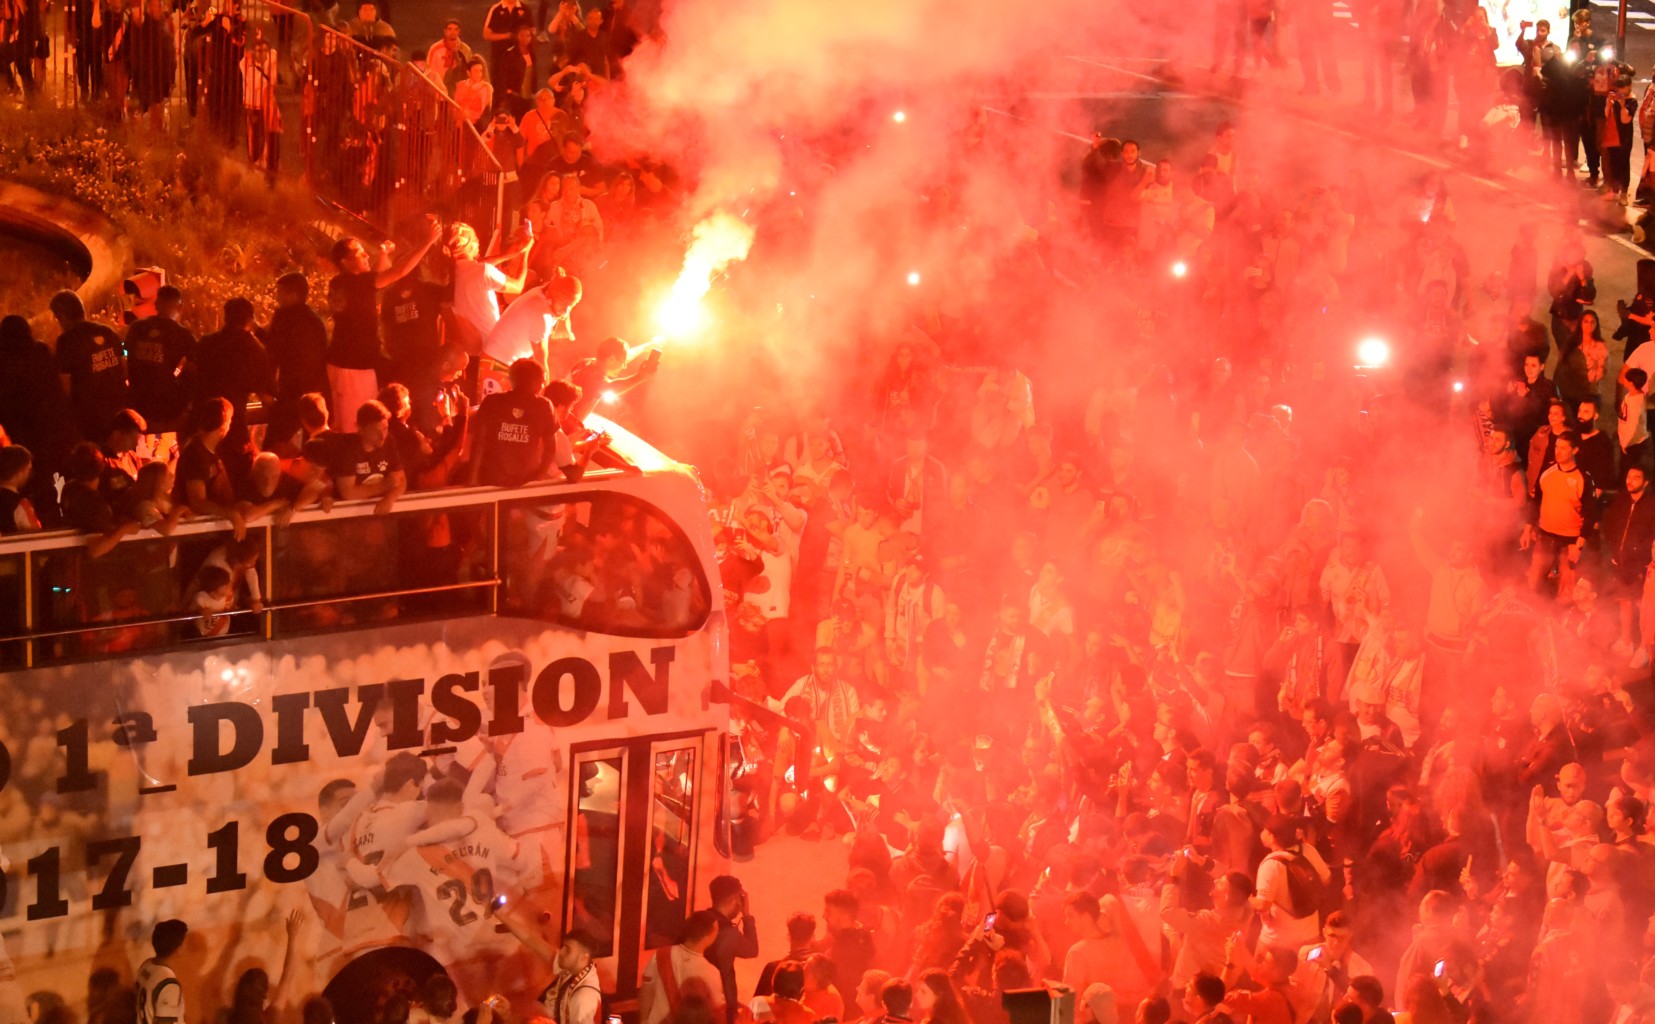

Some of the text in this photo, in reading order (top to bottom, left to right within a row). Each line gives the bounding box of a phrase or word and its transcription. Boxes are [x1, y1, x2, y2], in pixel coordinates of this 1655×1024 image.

[498, 431, 530, 443] ROSALES
[501, 422, 529, 435] BUFETE
[188, 646, 676, 776] DIVISION
[444, 842, 490, 864] BELTRÁN
[0, 812, 319, 920] 17-18
